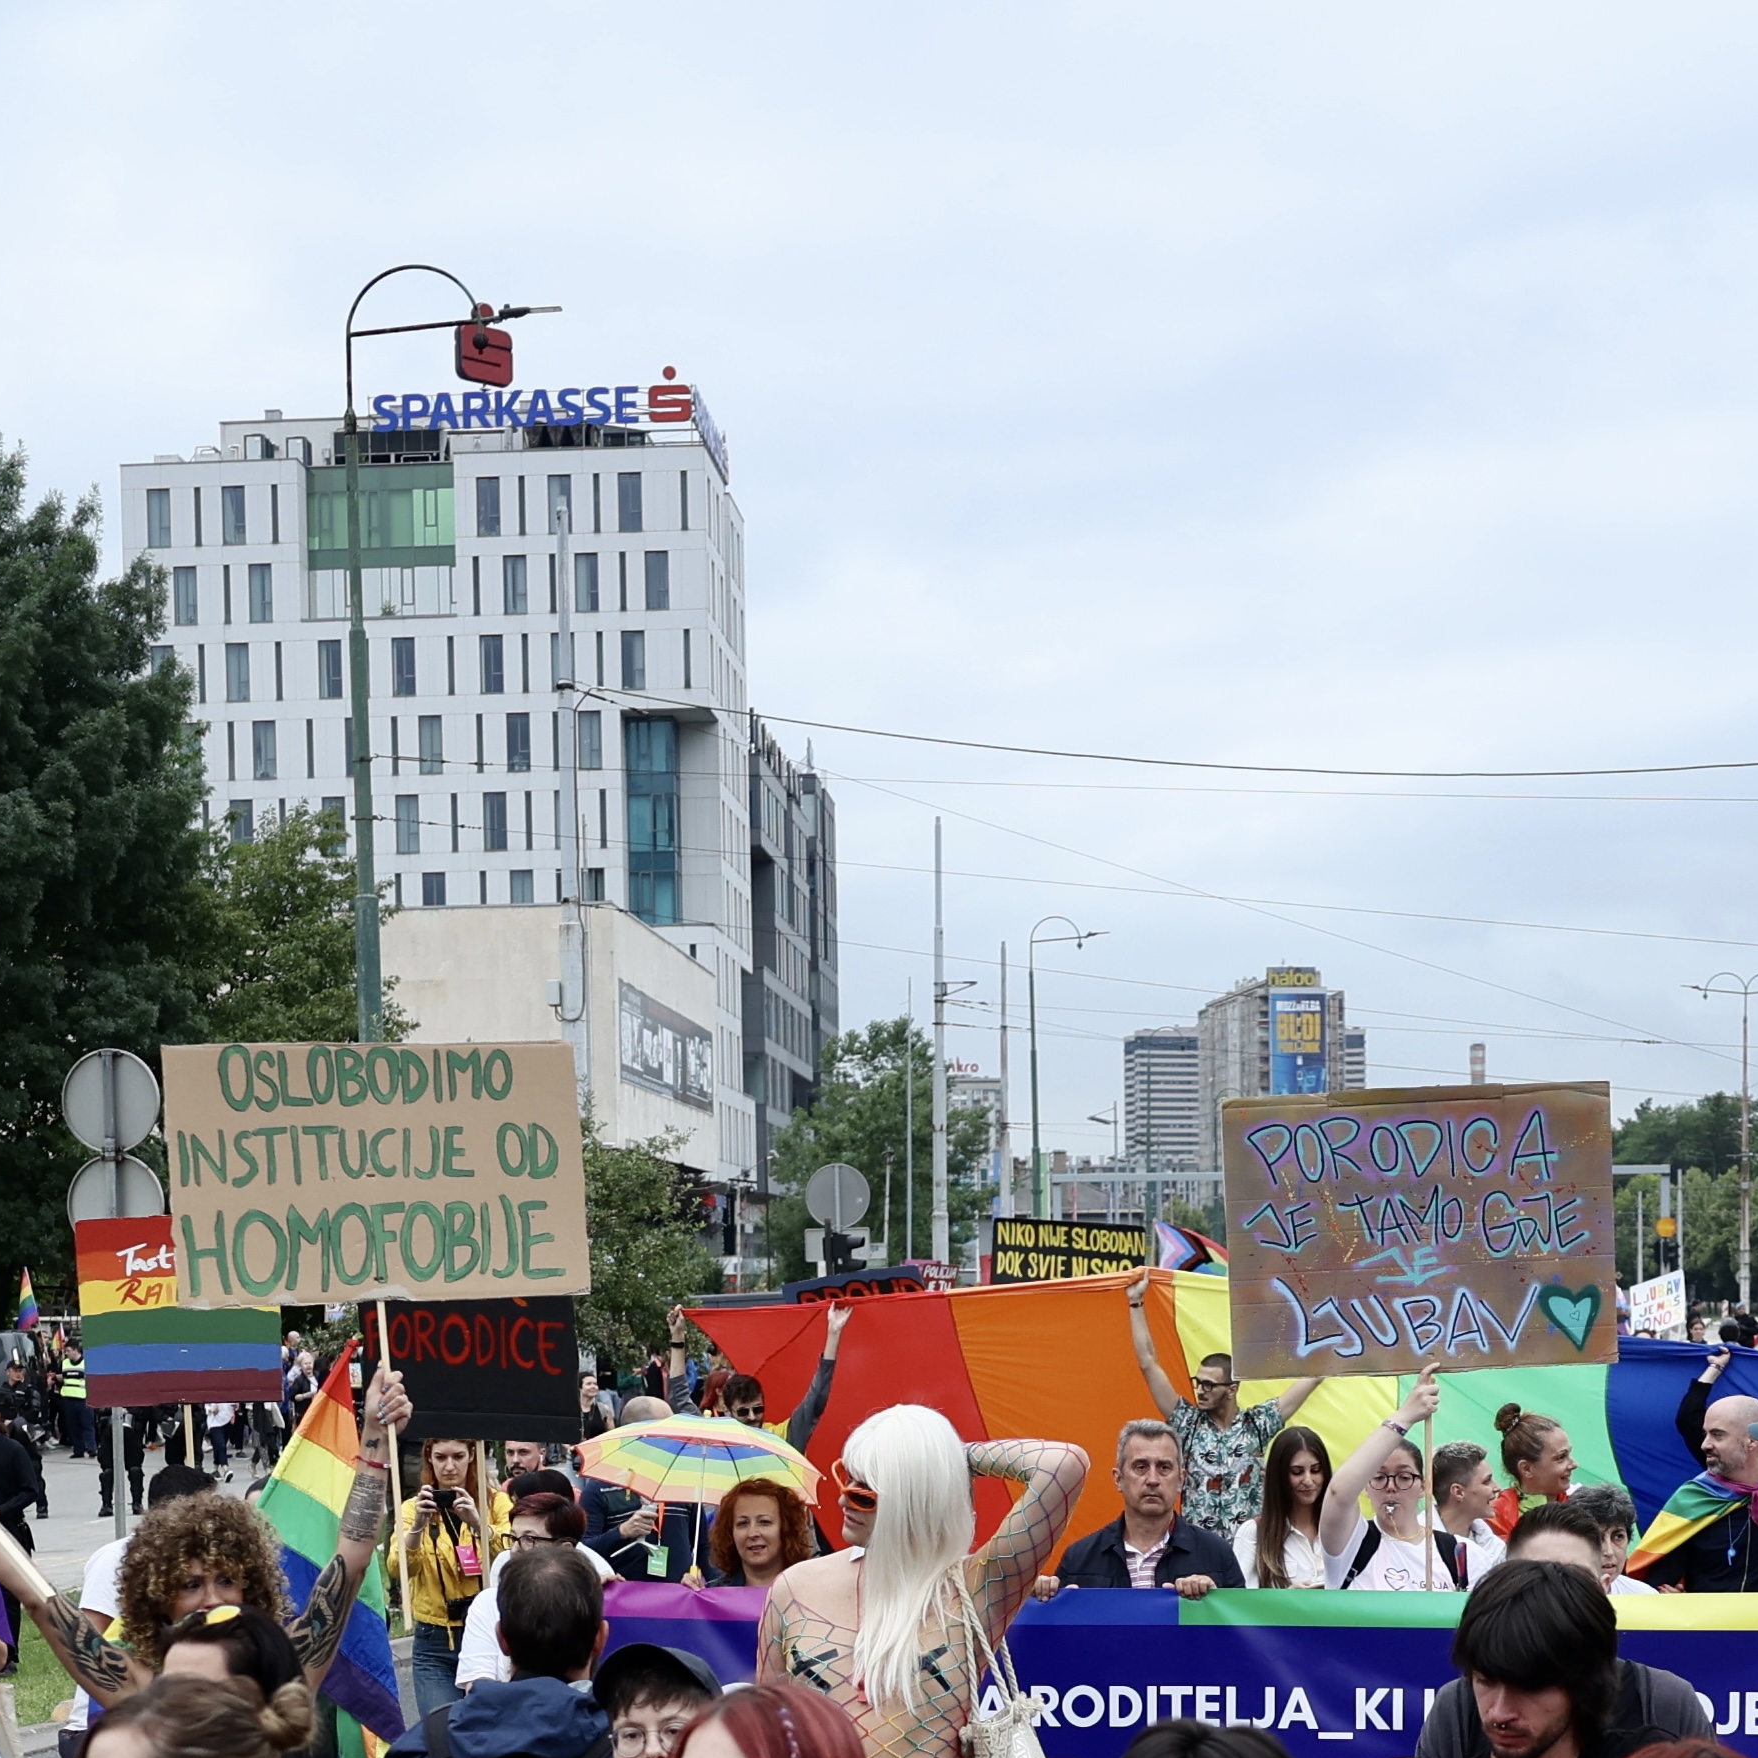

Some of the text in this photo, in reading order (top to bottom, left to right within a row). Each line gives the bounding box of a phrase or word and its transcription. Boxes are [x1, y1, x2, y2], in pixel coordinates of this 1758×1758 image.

[372, 386, 639, 432] SPARKASSE
[218, 1045, 512, 1112] OSLOBODIMO
[178, 1122, 559, 1188] INSTITUCIJE OD
[1246, 1110, 1558, 1185] PORODICA
[180, 1194, 567, 1298] HOMOFOBIJE
[997, 1221, 1146, 1257] NIKO NIJE SLOBODAN
[1243, 1202, 1319, 1252] JE
[1338, 1184, 1463, 1248] TAMO
[996, 1251, 1024, 1278] DOK
[1355, 1247, 1446, 1284] JE
[1632, 1278, 1681, 1307] LJUBAV
[1272, 1276, 1540, 1358] LJUBAV
[1639, 1304, 1654, 1318] JE
